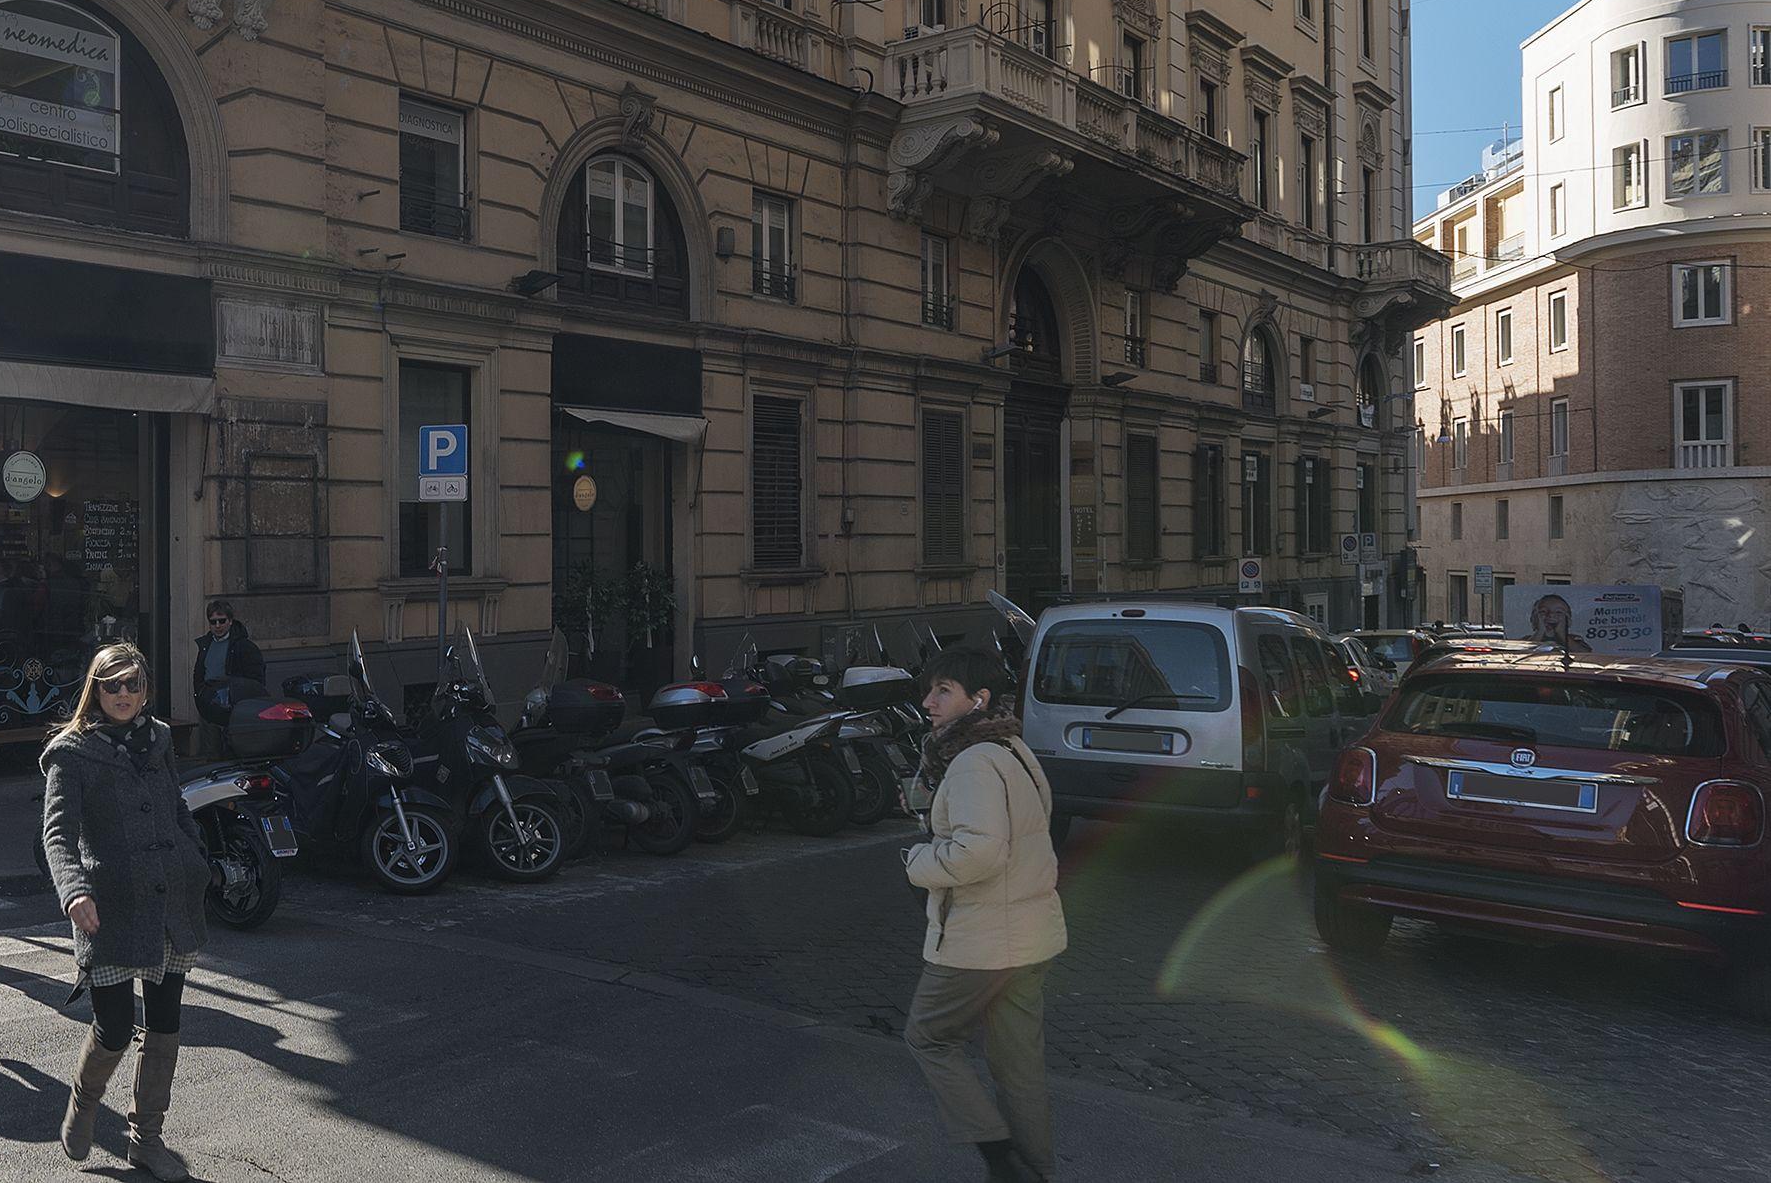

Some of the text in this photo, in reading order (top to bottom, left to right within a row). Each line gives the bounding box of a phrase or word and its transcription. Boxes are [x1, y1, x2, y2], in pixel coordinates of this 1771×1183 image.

[3, 26, 109, 62] neomedica
[30, 101, 77, 122] centro
[428, 430, 458, 471] P
[1594, 607, 1639, 616] Mamma
[1589, 616, 1608, 625] che
[1586, 627, 1653, 641] 803030
[1516, 753, 1533, 762] FIAT
